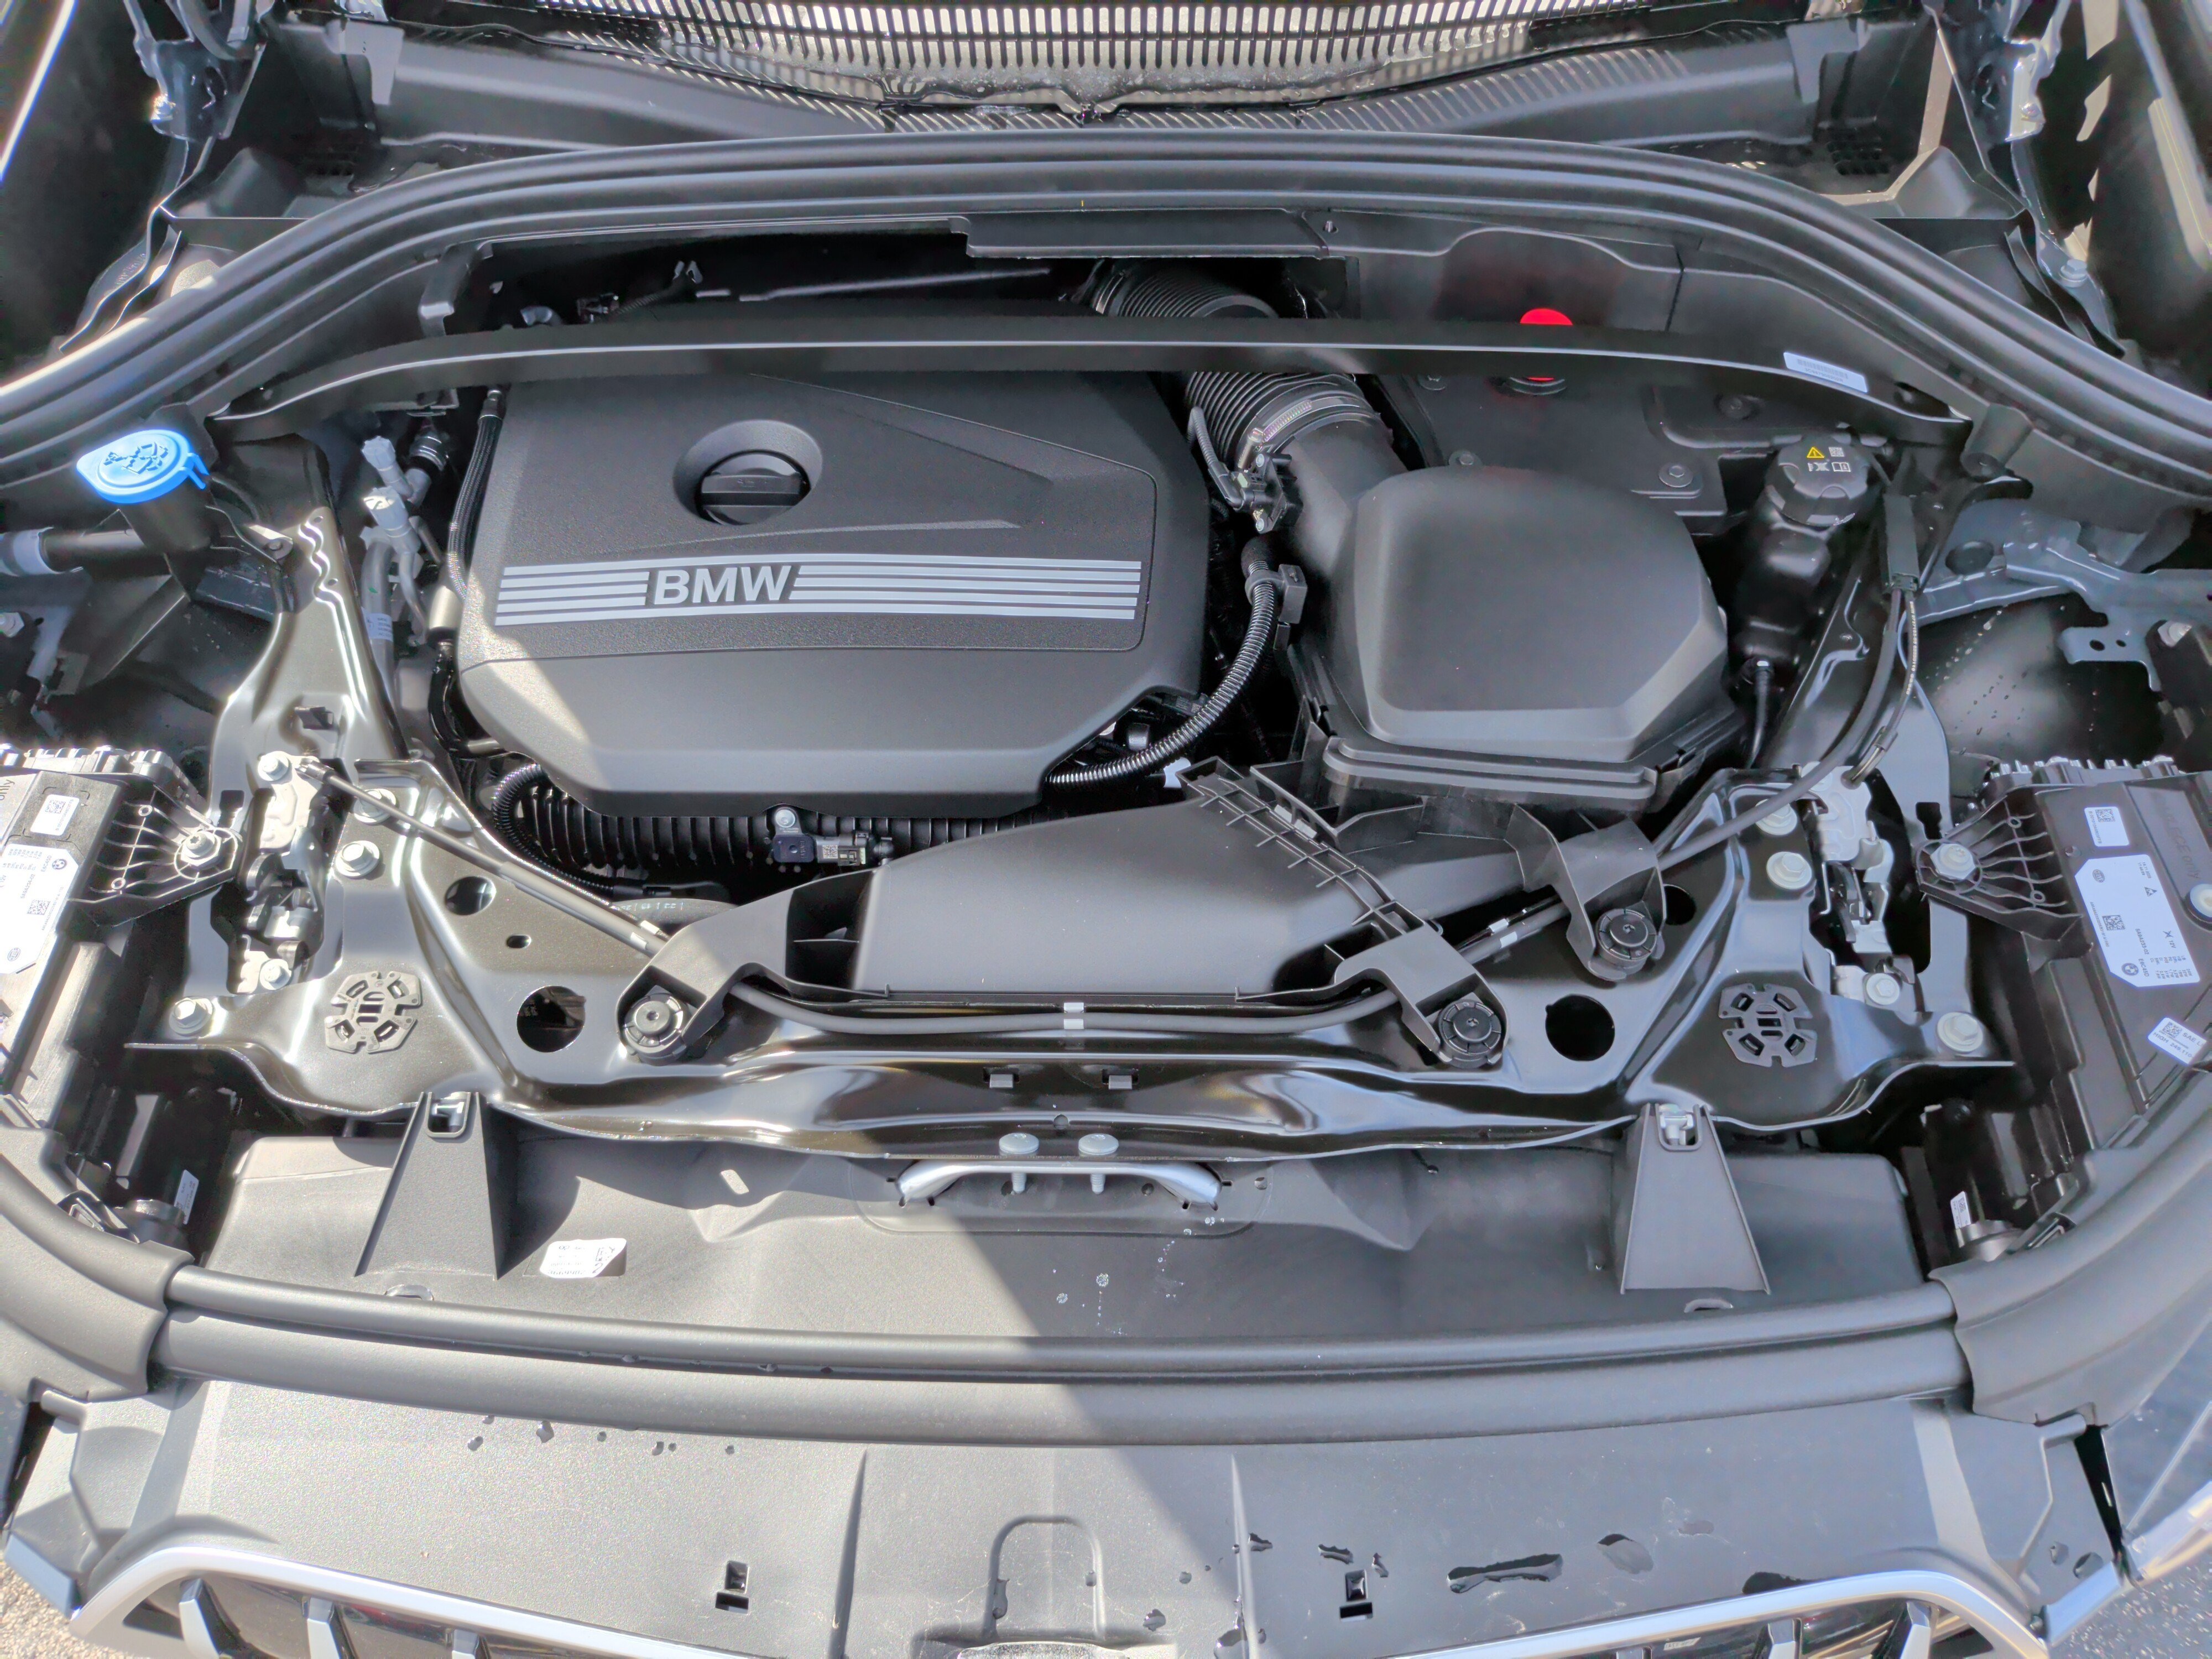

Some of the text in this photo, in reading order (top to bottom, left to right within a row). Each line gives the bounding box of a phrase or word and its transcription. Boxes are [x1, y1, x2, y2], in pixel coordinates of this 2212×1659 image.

[654, 565, 792, 605] BMW
[2153, 1032, 2169, 1043] HIGH
[2182, 1032, 2197, 1042] SAE
